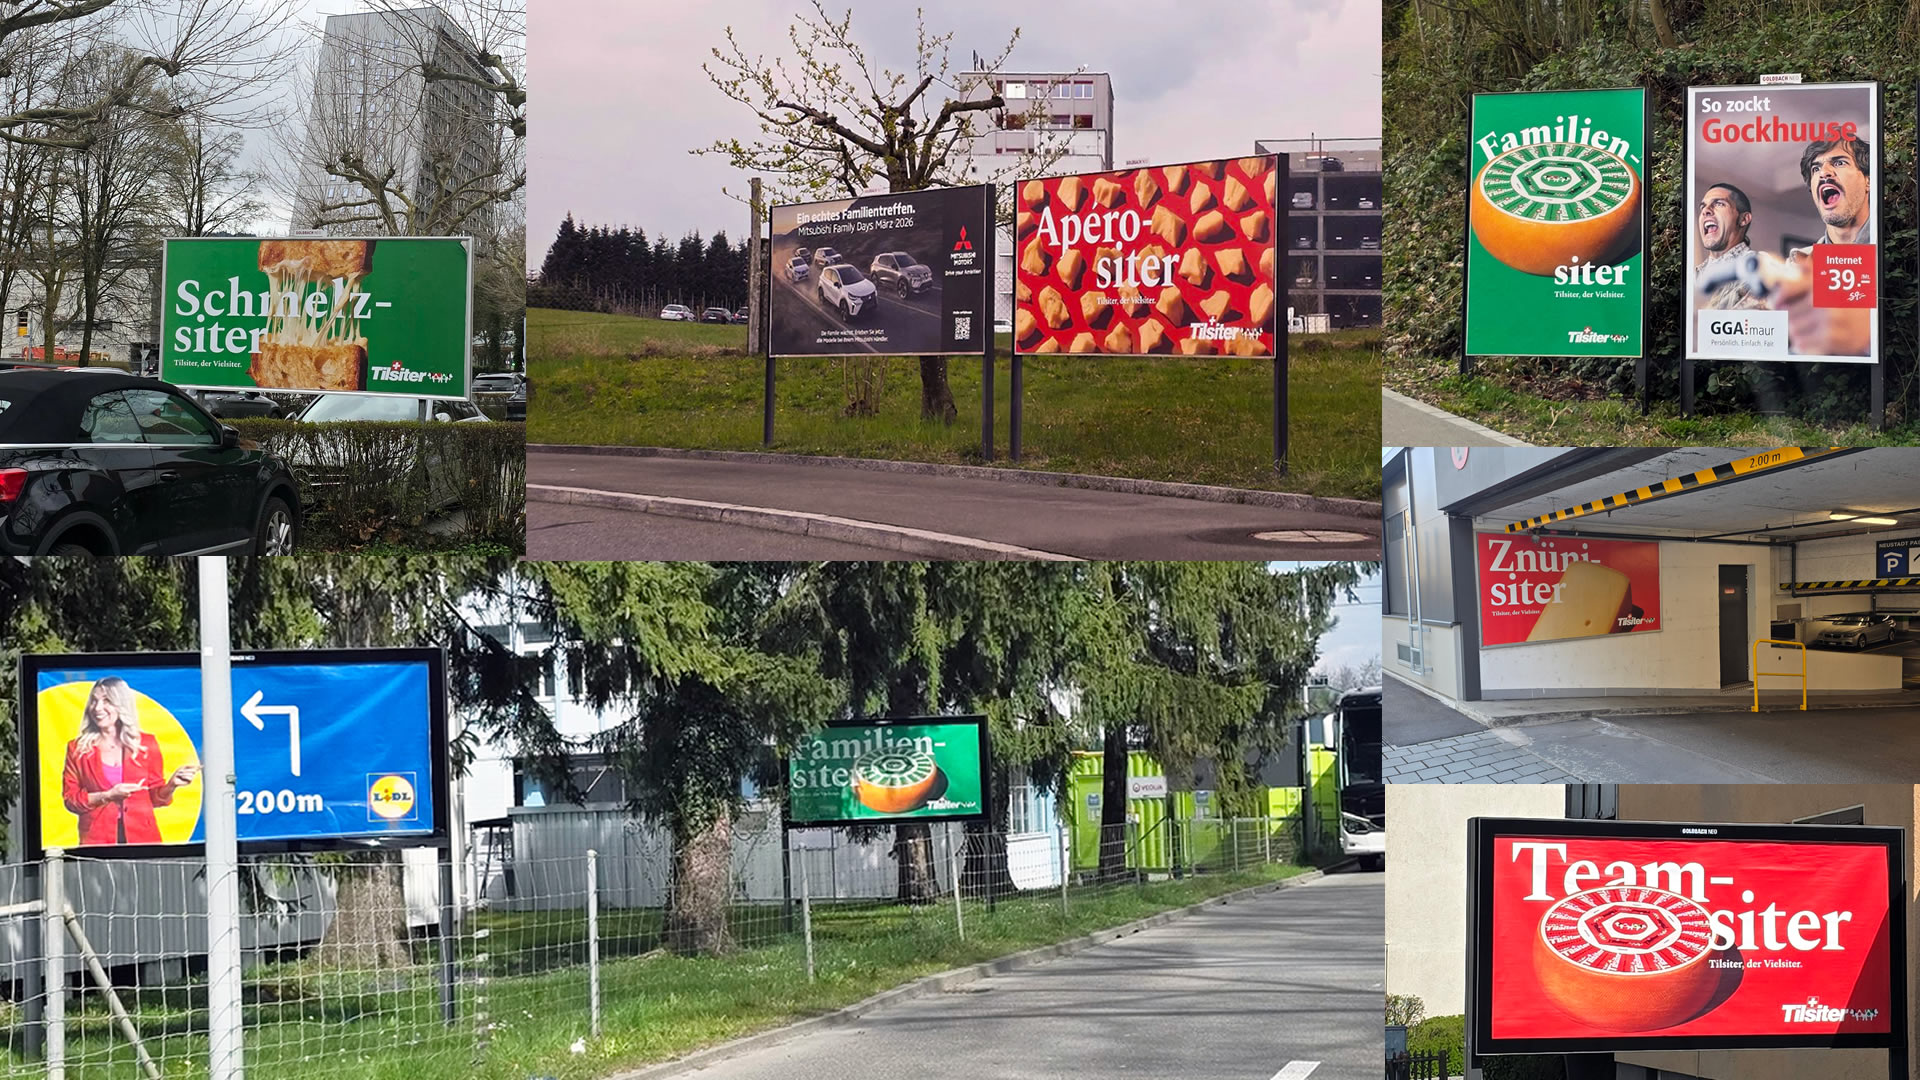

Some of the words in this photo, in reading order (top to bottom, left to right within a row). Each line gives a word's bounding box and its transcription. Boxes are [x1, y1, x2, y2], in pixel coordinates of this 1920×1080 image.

[1701, 98, 1721, 112] So
[1726, 96, 1770, 112] zockt
[1702, 115, 1857, 143] Gockhuuse
[1476, 115, 1640, 164] Familien-
[797, 213, 810, 223] Ein
[811, 211, 840, 222] echtes
[842, 202, 916, 220] Familientreffen.
[798, 225, 832, 236] Mitsubishi
[833, 223, 855, 233] Family
[857, 222, 874, 232] Days
[875, 219, 893, 229] März
[895, 217, 914, 228] 2026
[1037, 201, 1152, 259] Apéro-
[1096, 241, 1180, 289] siter
[1826, 255, 1862, 265] Internet
[1554, 255, 1630, 285] siter
[175, 276, 392, 319] Schmelz-
[1554, 291, 1581, 299] Tilsiter,
[174, 314, 268, 354] siter
[1190, 322, 1240, 340] Tilsiter
[1568, 331, 1609, 343] Tilsiter
[1711, 321, 1744, 335] GGA
[1749, 326, 1775, 335] maur
[174, 359, 200, 368] Tilsiter,
[200, 359, 212, 367] der
[212, 360, 242, 368] Vielsiter.
[371, 366, 427, 382] Tilsiter
[1750, 454, 1769, 468] 2.00
[1772, 453, 1781, 462] m
[1489, 540, 1600, 572] Znüni-
[1887, 558, 1899, 572] P
[1490, 573, 1567, 606] siter
[1618, 617, 1643, 626] Tilsiter
[237, 789, 323, 815] 200m
[1512, 842, 1734, 902] Team-
[1711, 890, 1852, 950] siter
[1709, 959, 1745, 970] Tilsiter,
[1746, 959, 1762, 968] der
[1763, 959, 1803, 968] Vielsiter.
[1782, 1004, 1848, 1022] Tilsiter
